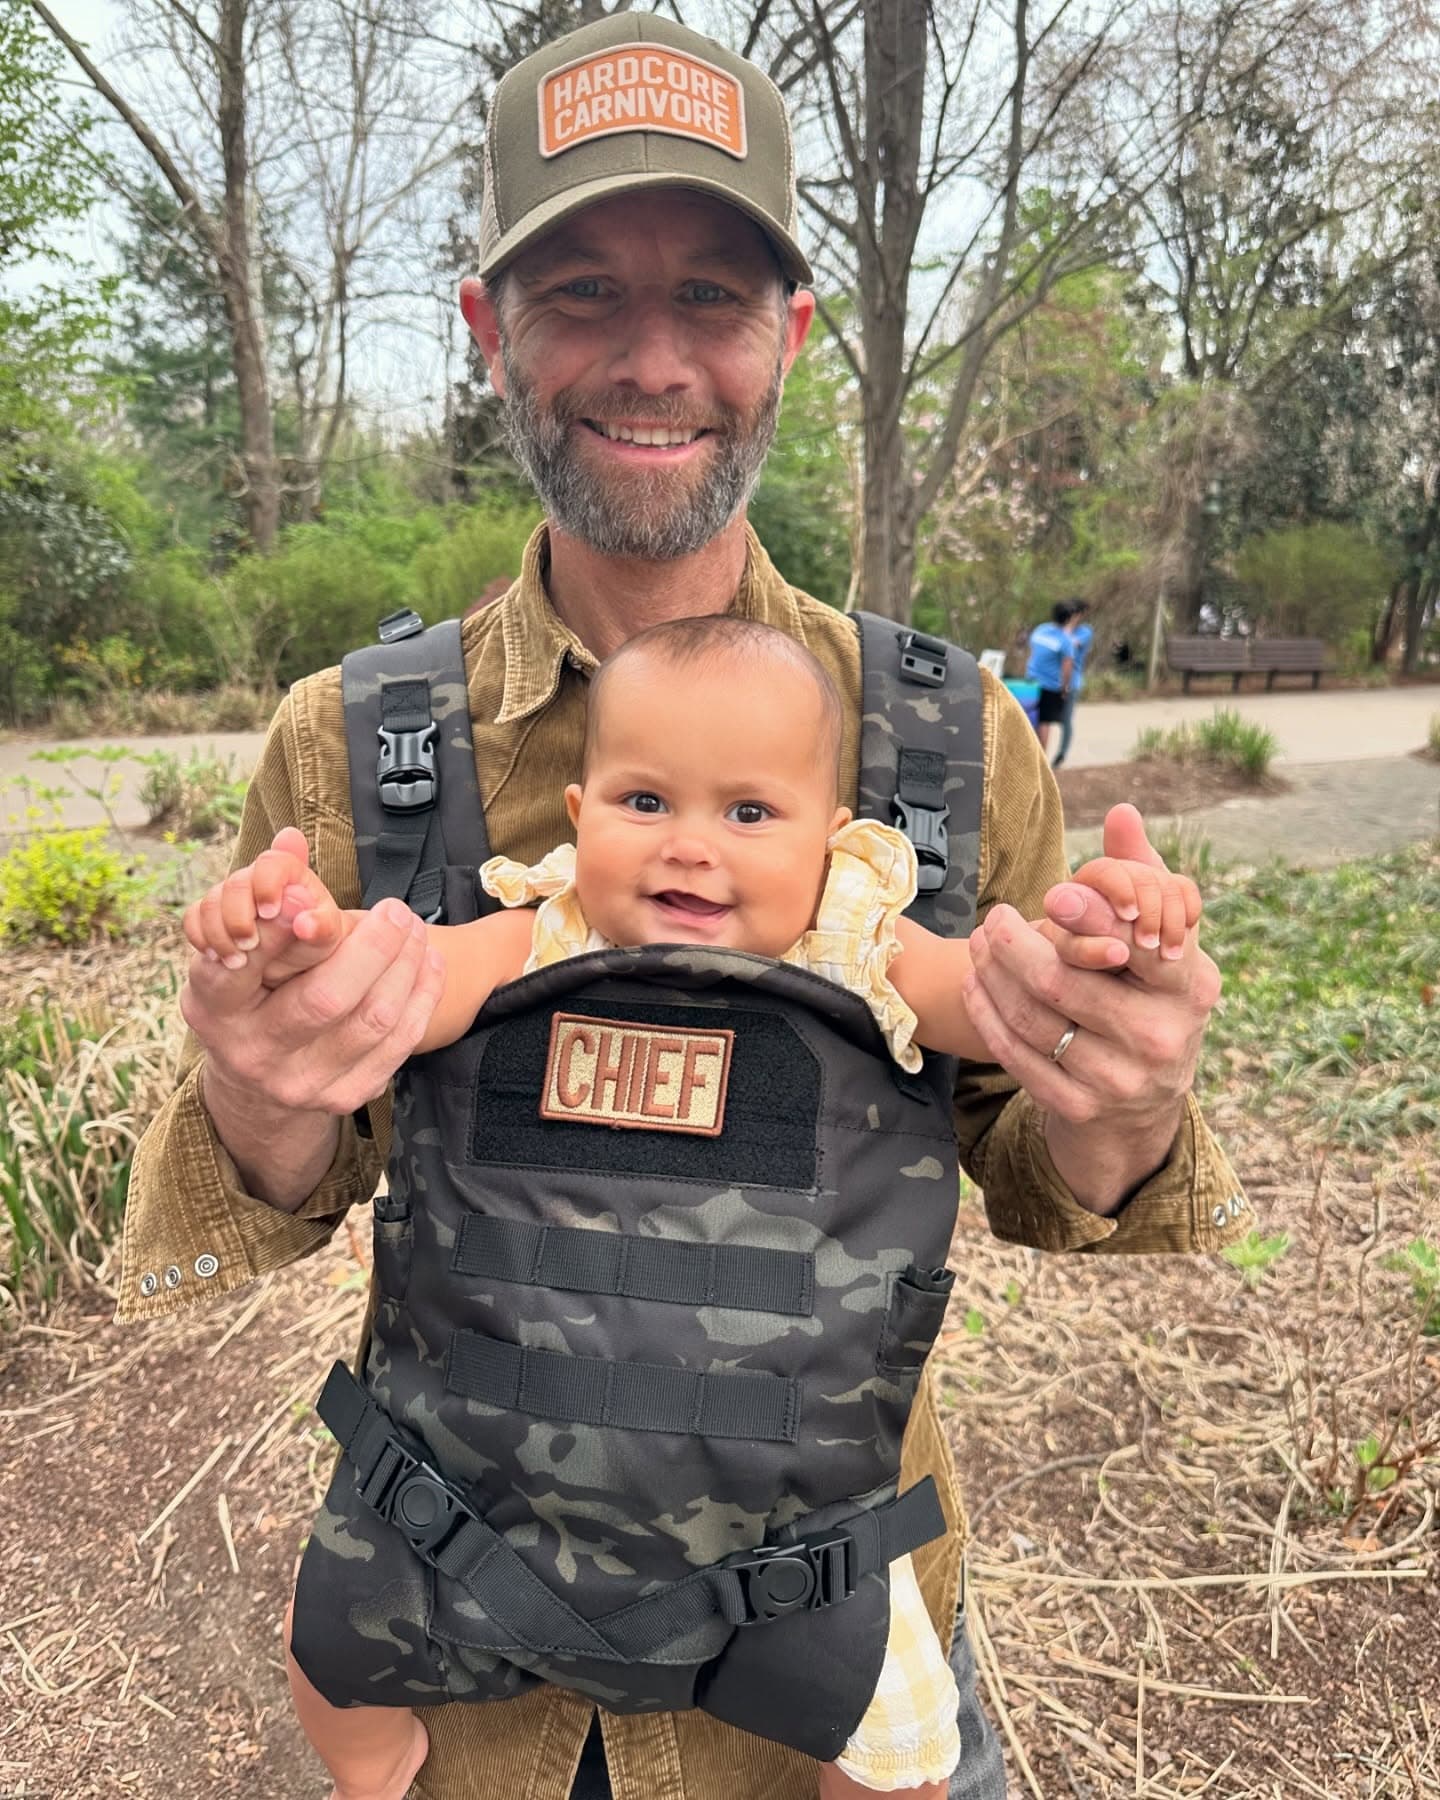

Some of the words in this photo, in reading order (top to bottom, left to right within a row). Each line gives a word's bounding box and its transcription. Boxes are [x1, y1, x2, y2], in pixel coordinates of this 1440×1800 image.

[553, 56, 730, 112] HARDCORE
[553, 87, 732, 142] CARNIVORE
[557, 1027, 720, 1119] CHIEF
